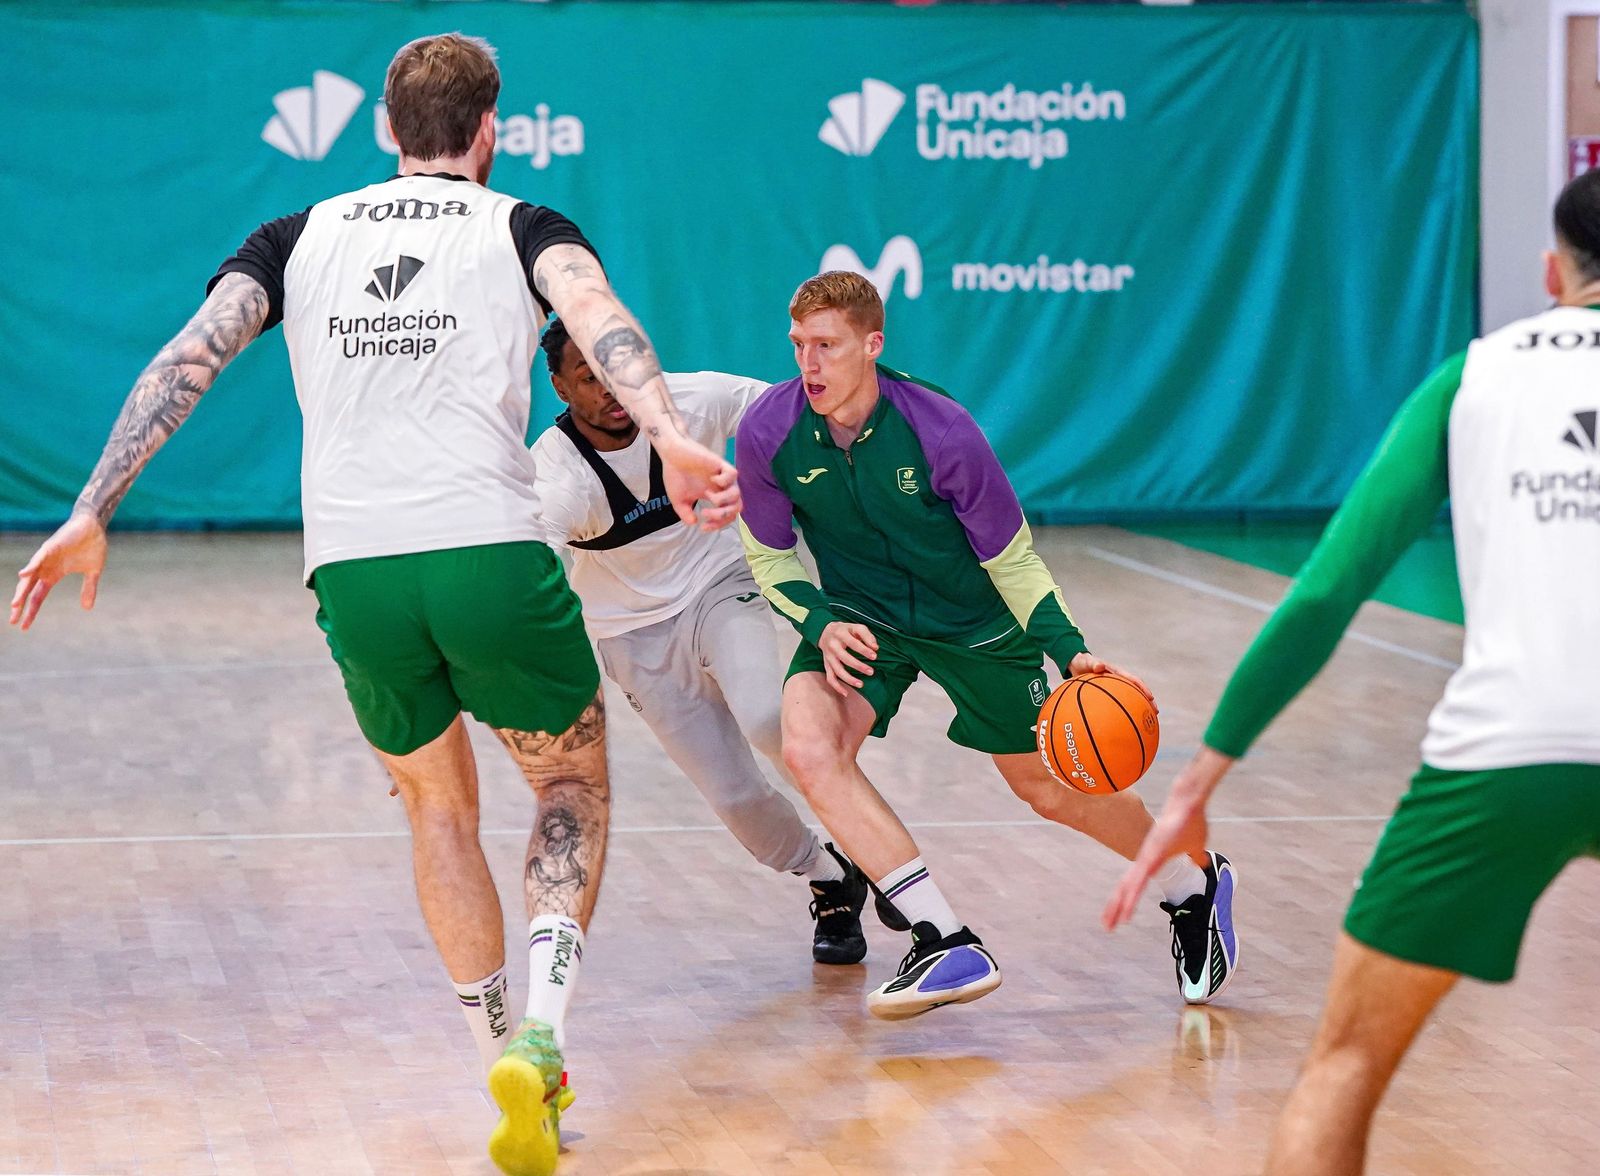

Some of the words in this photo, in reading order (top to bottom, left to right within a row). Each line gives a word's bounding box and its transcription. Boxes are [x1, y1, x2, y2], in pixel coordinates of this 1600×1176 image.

[916, 82, 1125, 121] Fundación
[916, 118, 1068, 170] Unicaja
[952, 254, 1135, 293] movistar
[328, 310, 457, 338] Fundación
[342, 334, 437, 361] Unicaja
[1064, 722, 1084, 771] endesa
[548, 929, 575, 986] UNICAJA
[484, 984, 507, 1039] UNICAJA
